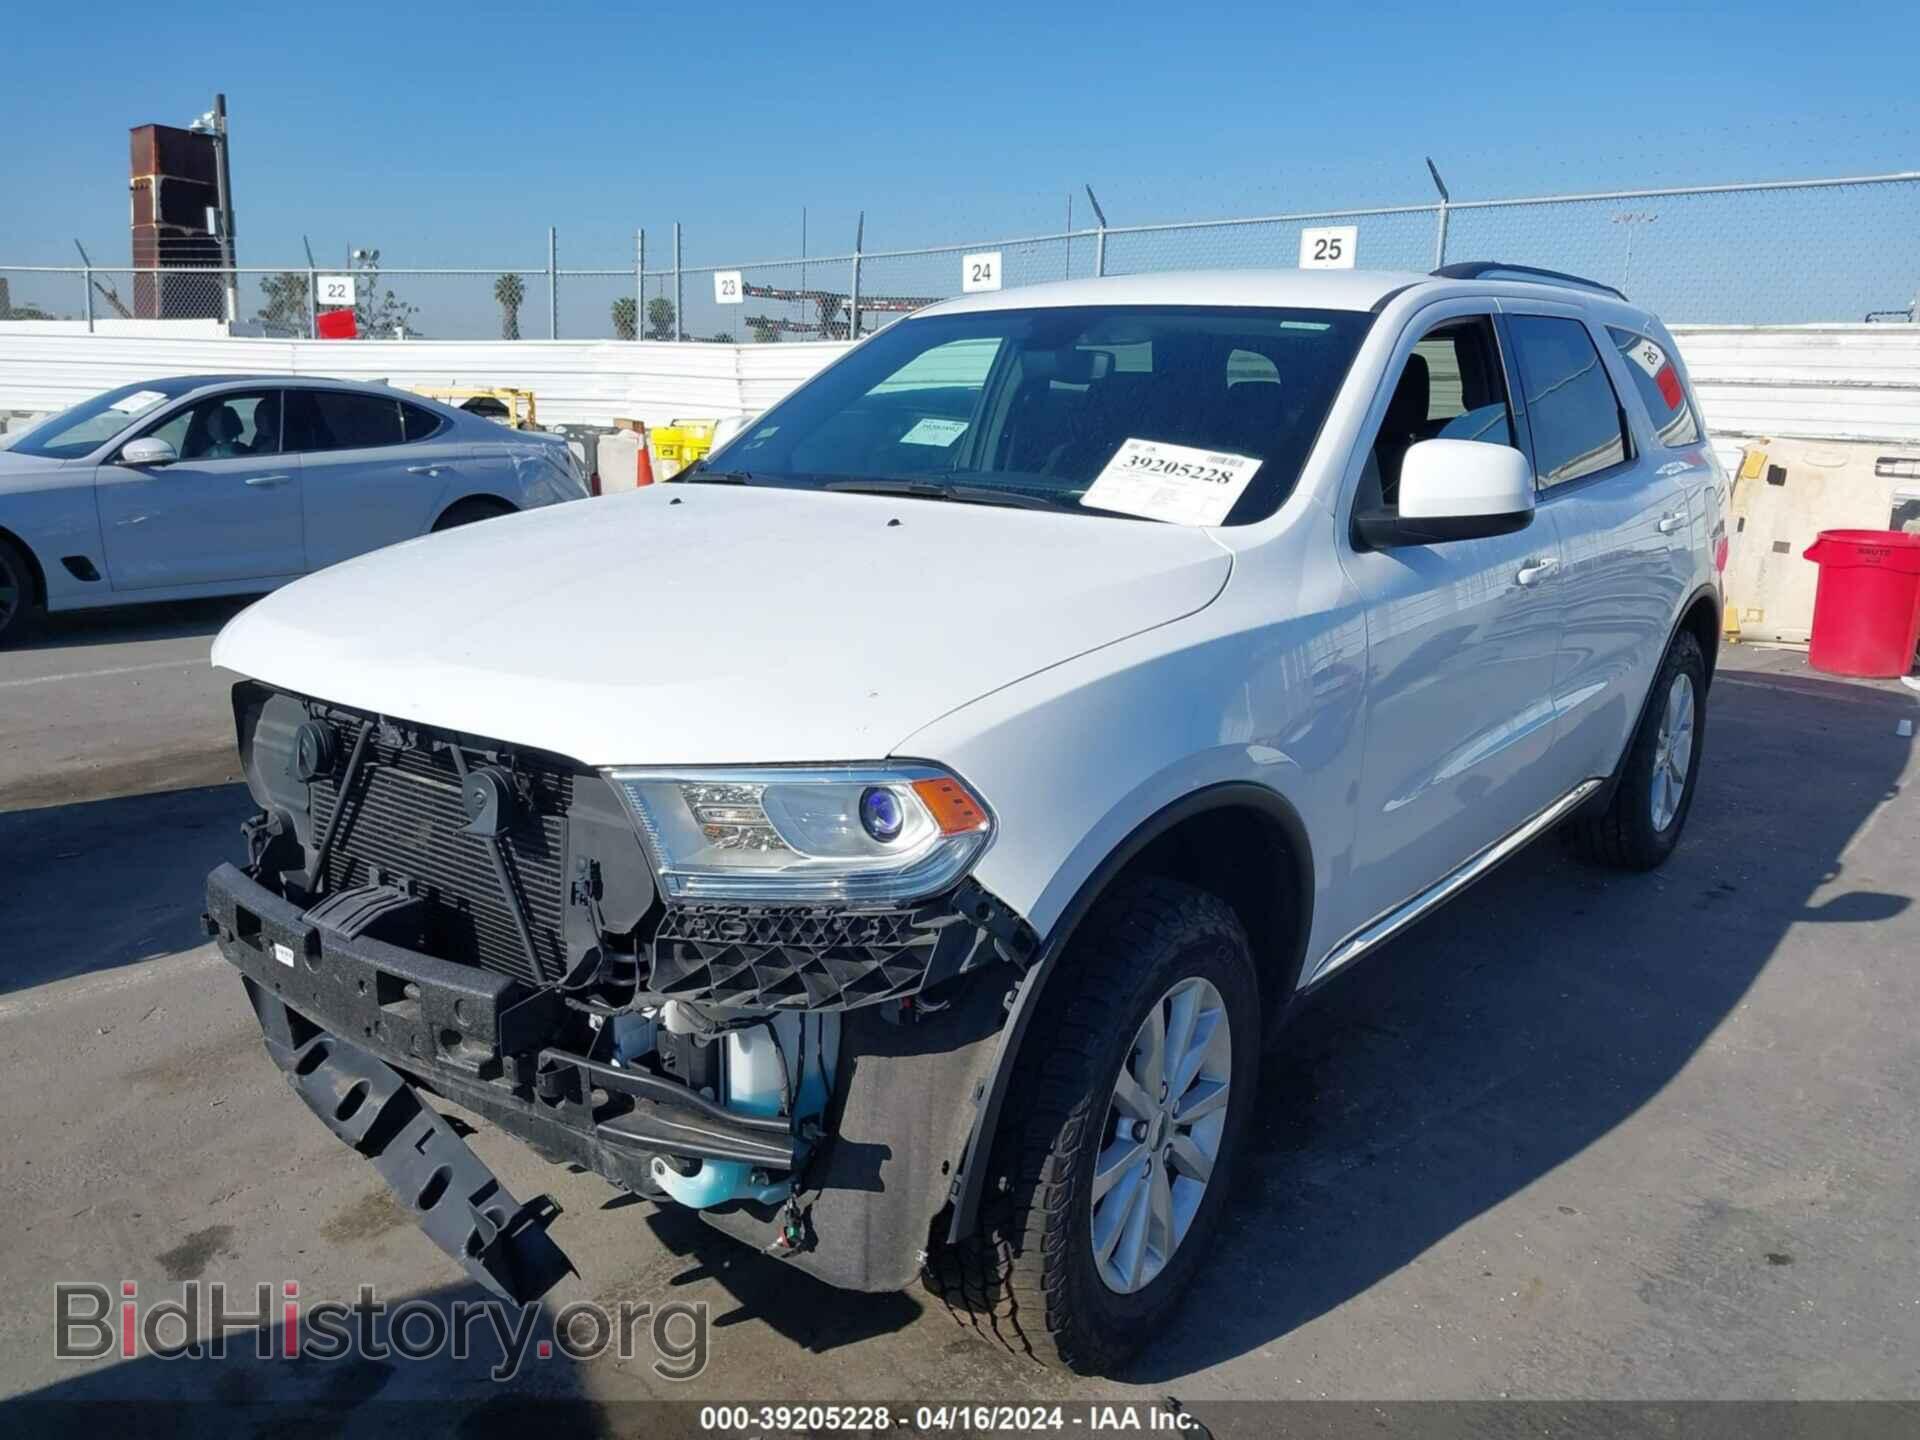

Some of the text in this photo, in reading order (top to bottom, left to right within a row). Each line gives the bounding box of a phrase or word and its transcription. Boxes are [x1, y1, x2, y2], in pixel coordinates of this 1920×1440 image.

[1314, 238, 1342, 260] 25
[972, 263, 992, 282] 24
[327, 284, 346, 298] 22
[721, 279, 736, 296] 23
[1123, 455, 1233, 485] 39205228
